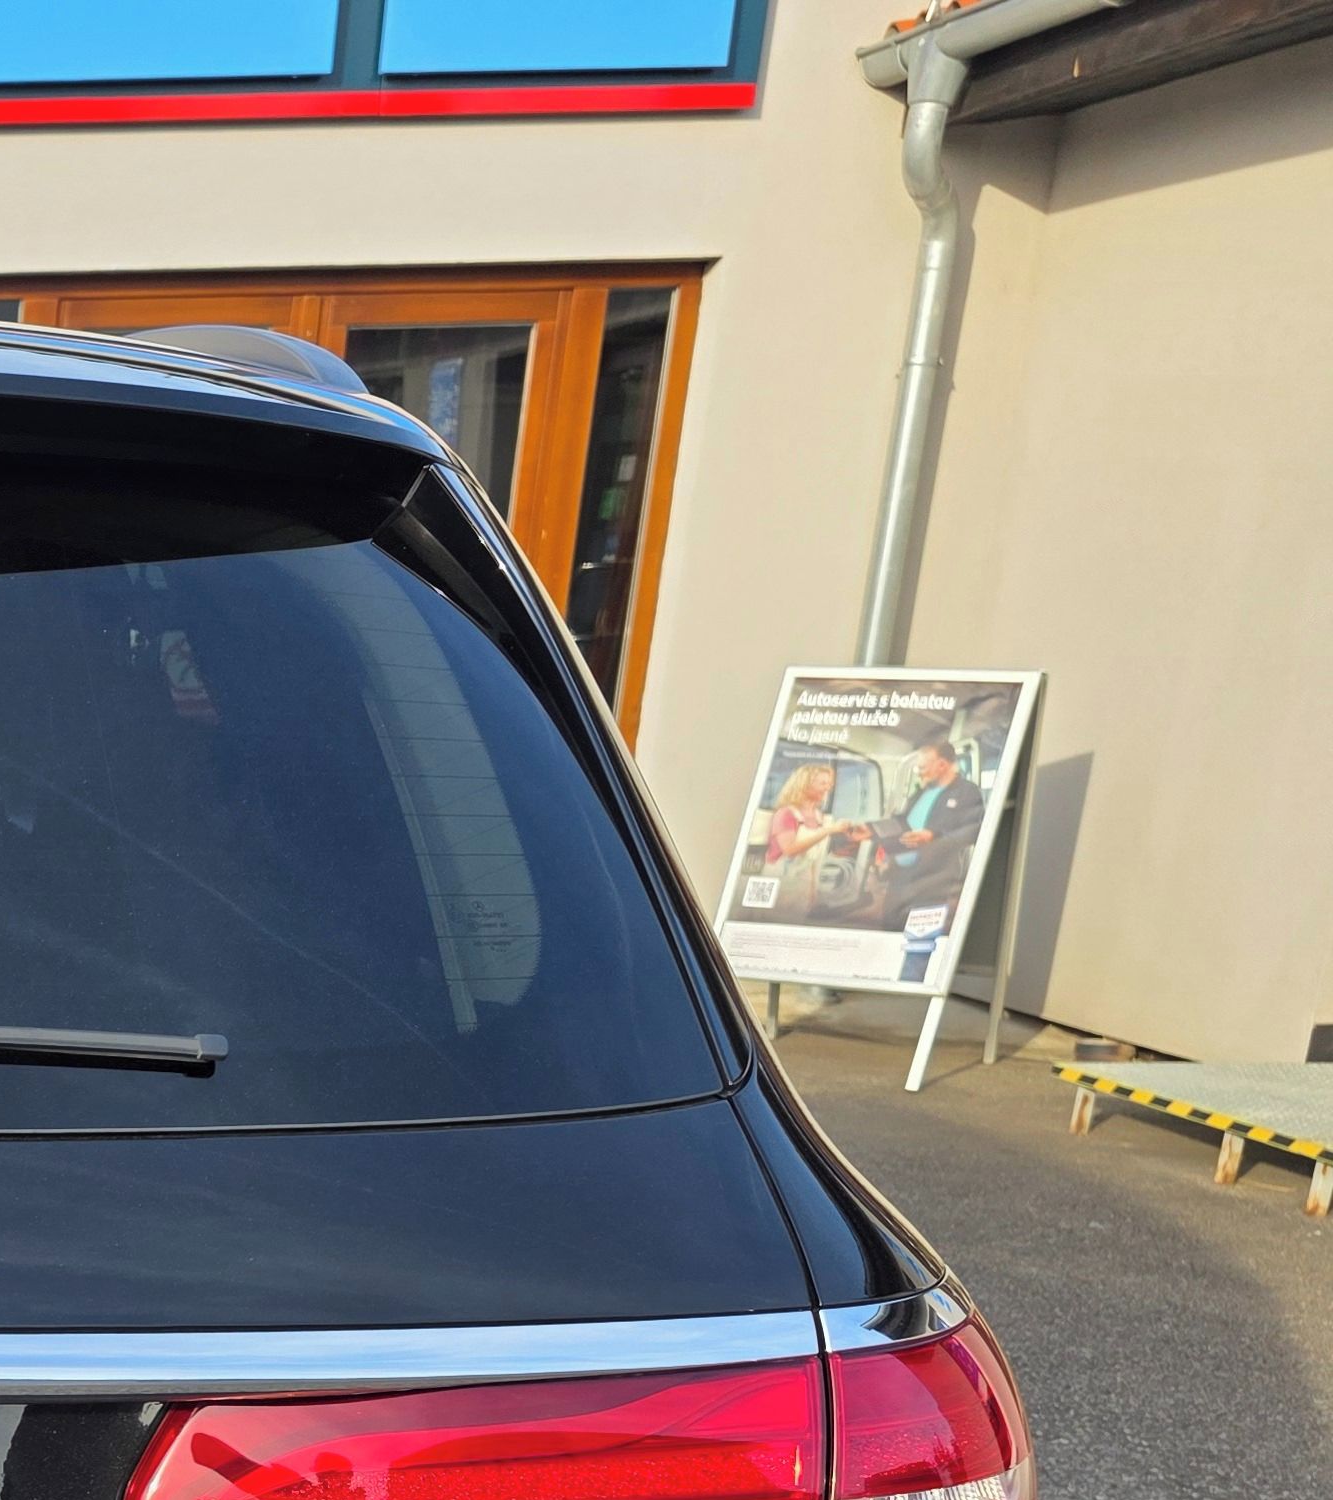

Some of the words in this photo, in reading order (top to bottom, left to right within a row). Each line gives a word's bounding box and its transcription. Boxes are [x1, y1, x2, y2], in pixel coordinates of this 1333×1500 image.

[797, 690, 878, 708] Autoservis
[879, 694, 890, 708] s
[890, 691, 956, 710] bohatou
[791, 709, 849, 728] paletou
[850, 709, 901, 727] služeb
[787, 727, 808, 742] No
